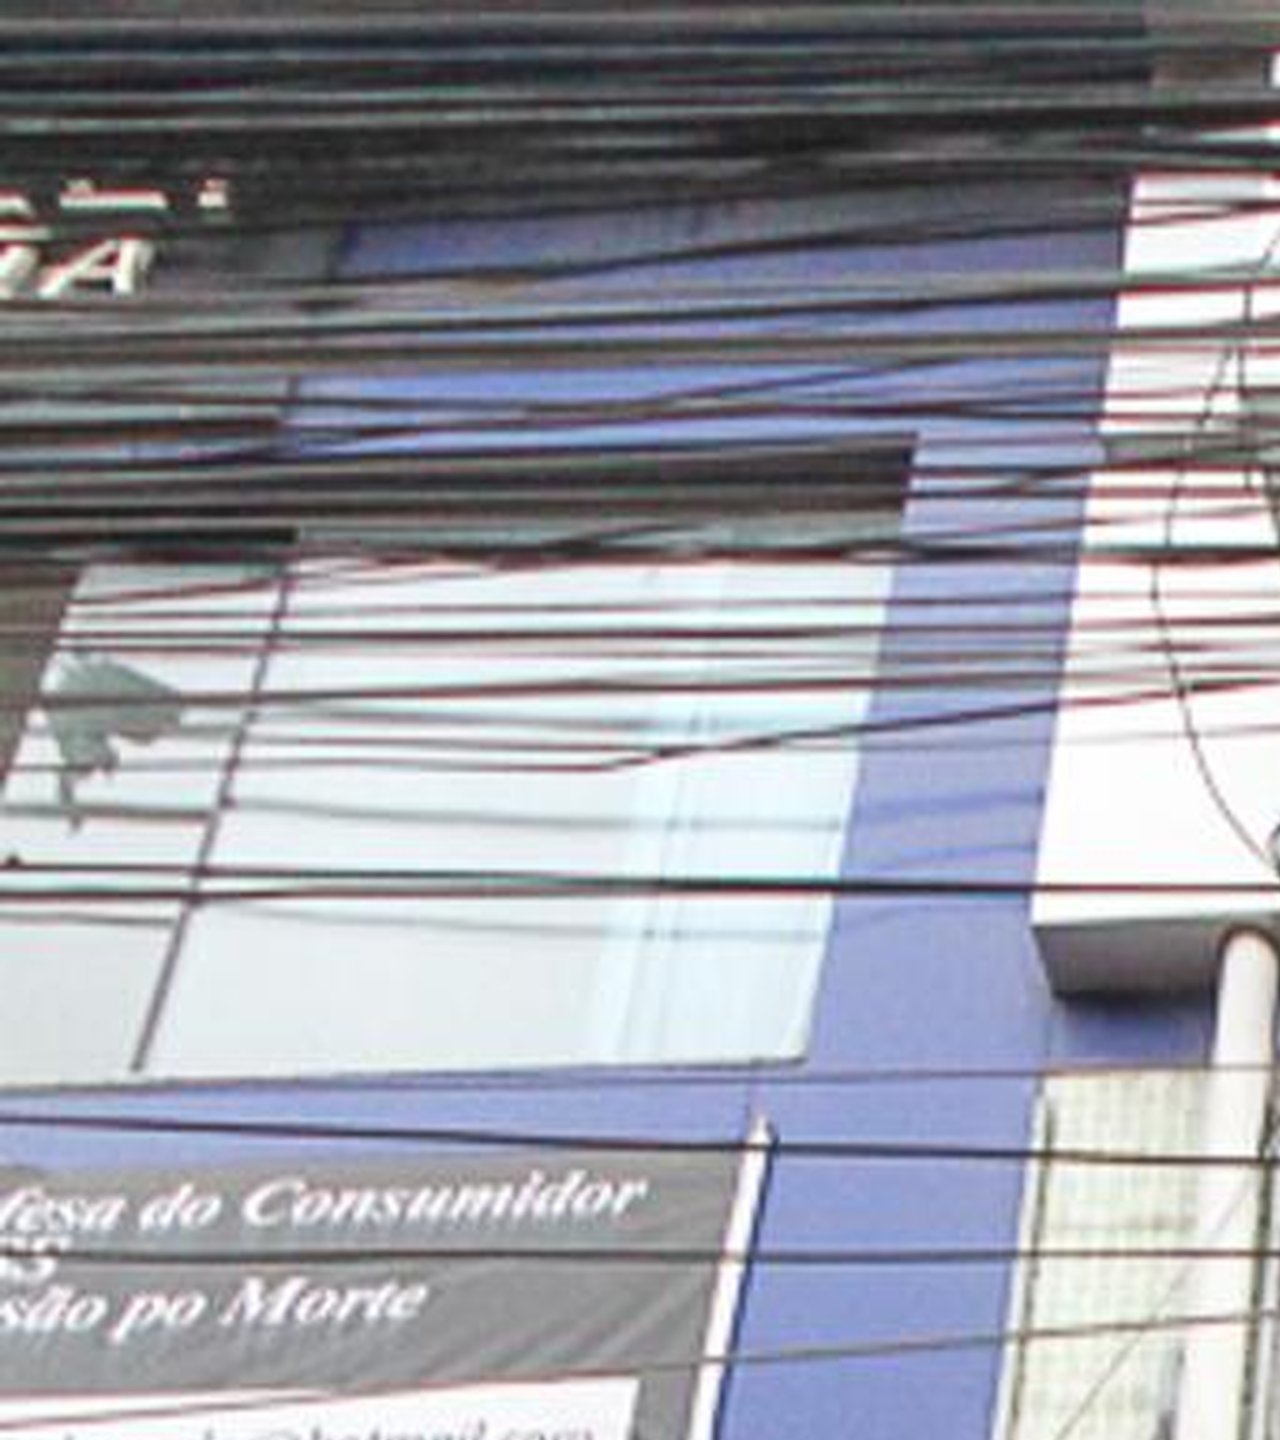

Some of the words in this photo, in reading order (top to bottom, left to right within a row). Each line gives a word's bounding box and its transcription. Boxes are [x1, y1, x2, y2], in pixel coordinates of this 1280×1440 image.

[139, 1182, 222, 1230] do
[242, 1168, 646, 1227] Consumidor
[108, 1289, 205, 1344] po
[219, 1276, 428, 1326] Morte
